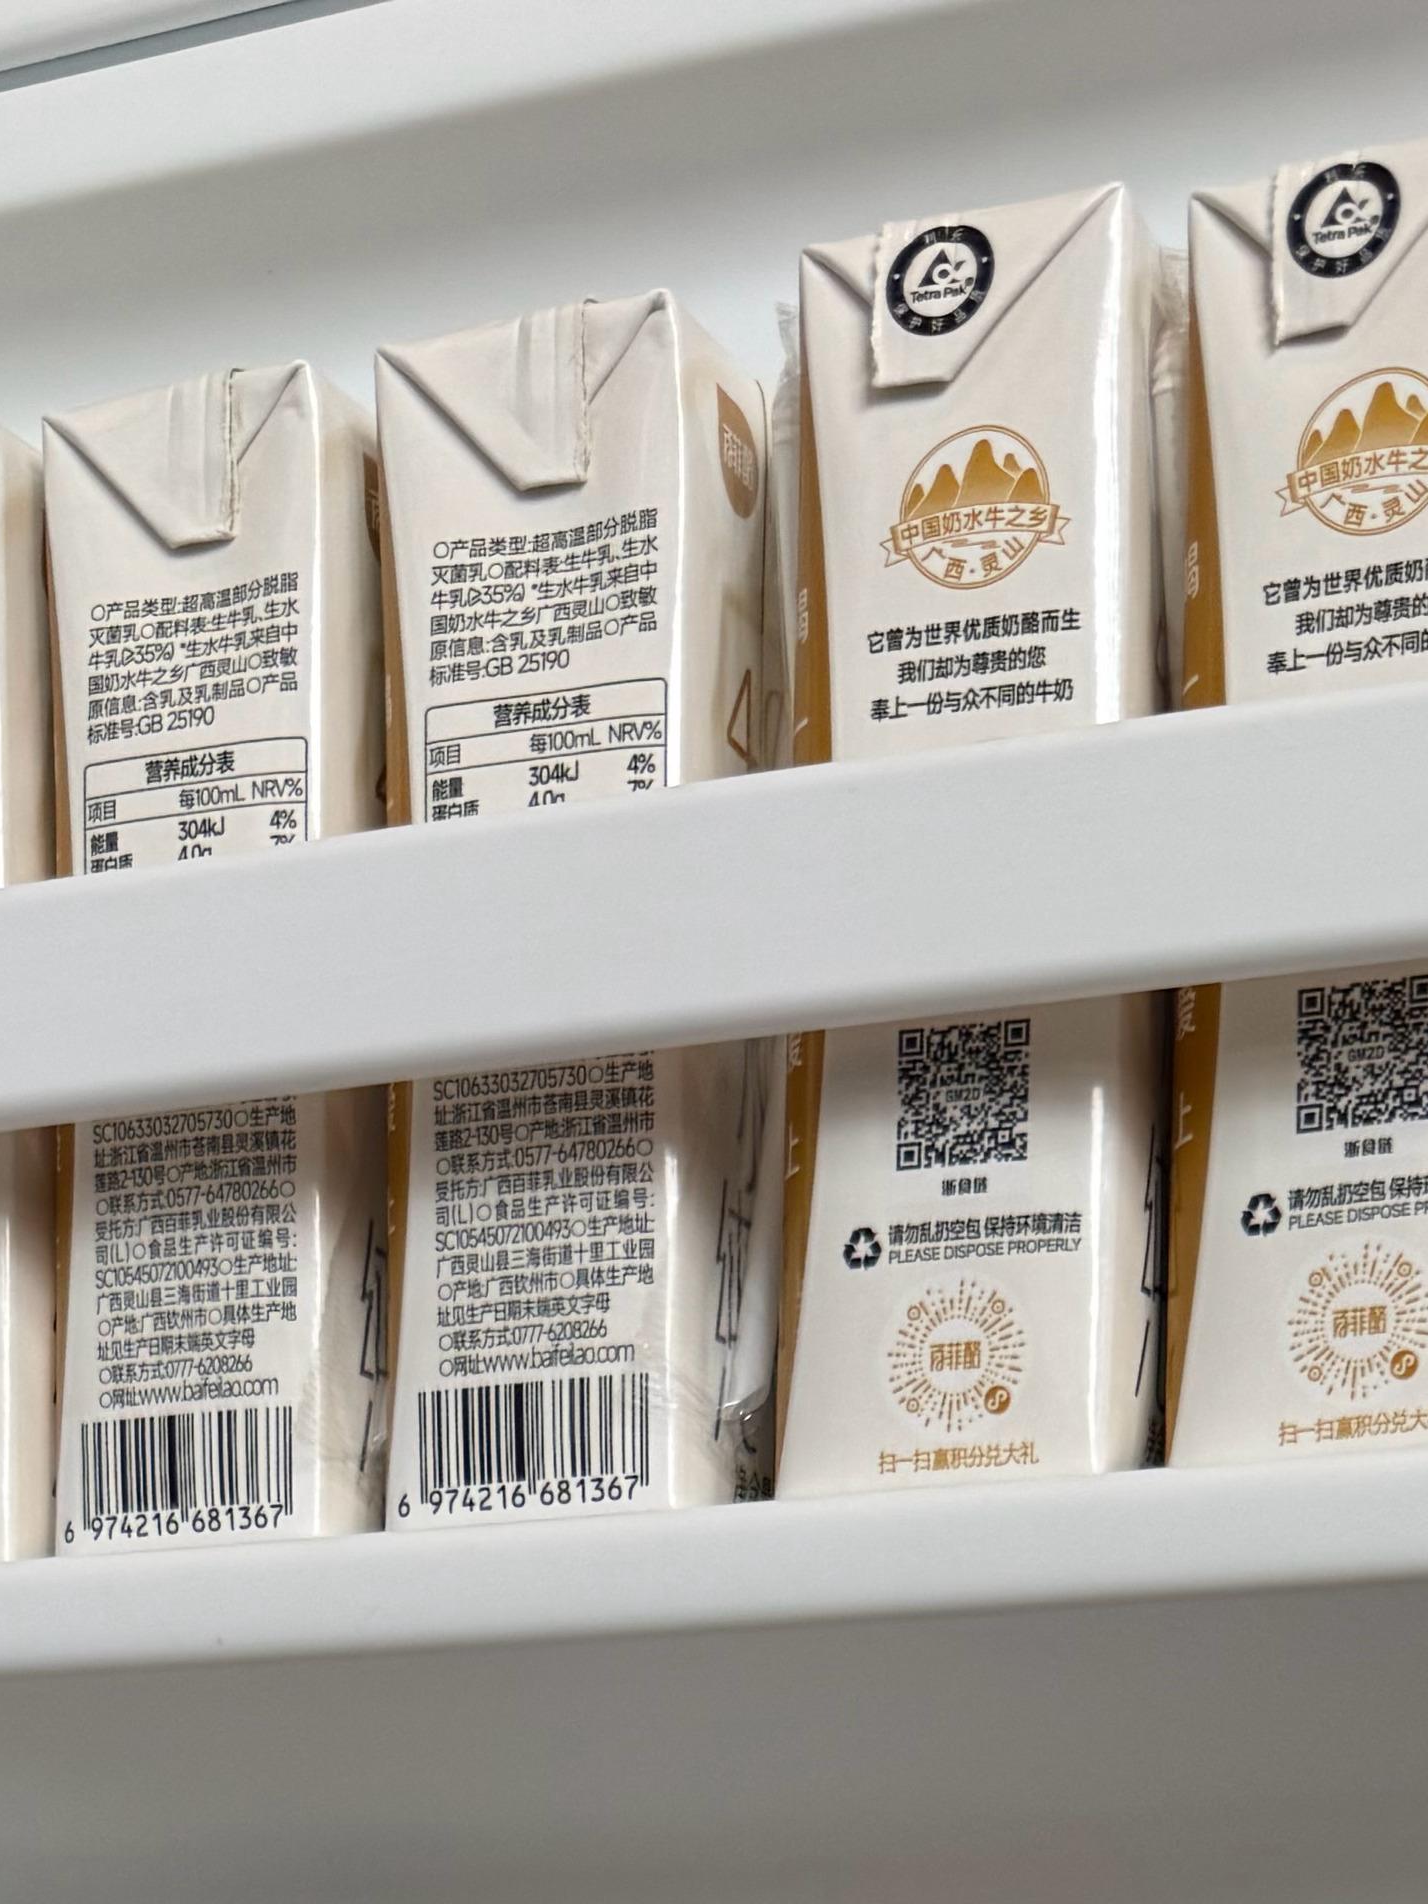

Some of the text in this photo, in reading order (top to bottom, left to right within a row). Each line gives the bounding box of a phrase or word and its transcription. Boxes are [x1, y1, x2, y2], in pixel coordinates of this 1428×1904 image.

[910, 286, 966, 304] Tetra Pak
[901, 505, 1049, 544] 中国奶水牛之乡
[868, 608, 1082, 654] 它曾为世界优质奶酪而生
[518, 650, 569, 673] 25190
[898, 645, 1046, 684] 我们却为尊贵的您
[168, 706, 215, 731] 25190
[494, 694, 590, 728] 营养成分表
[871, 679, 1073, 722] 奉上一份与众不同的牛奶
[430, 720, 661, 768] 项目 每100mL NRV%
[146, 751, 234, 784] 营养成分表
[433, 753, 655, 800] 能量 304kJ 4%
[88, 778, 303, 822] 项目 每100mL NRV%
[91, 810, 296, 856] 能量 304kJ 4%
[1288, 1180, 1386, 1210] 请勿乱扔空包
[888, 1212, 1082, 1246] 请勿乱扔空包 保持环境清洁
[1289, 1210, 1343, 1229] PLEASE
[1347, 1202, 1410, 1223] DISPOSE
[889, 1238, 1081, 1264] PLEASE DISPOSE PROPERLY
[879, 1442, 1039, 1474] 扫一扫赢积分兑大礼
[399, 1476, 639, 1518] 6 974216 681367
[65, 1505, 284, 1543] 6 974216 681367
